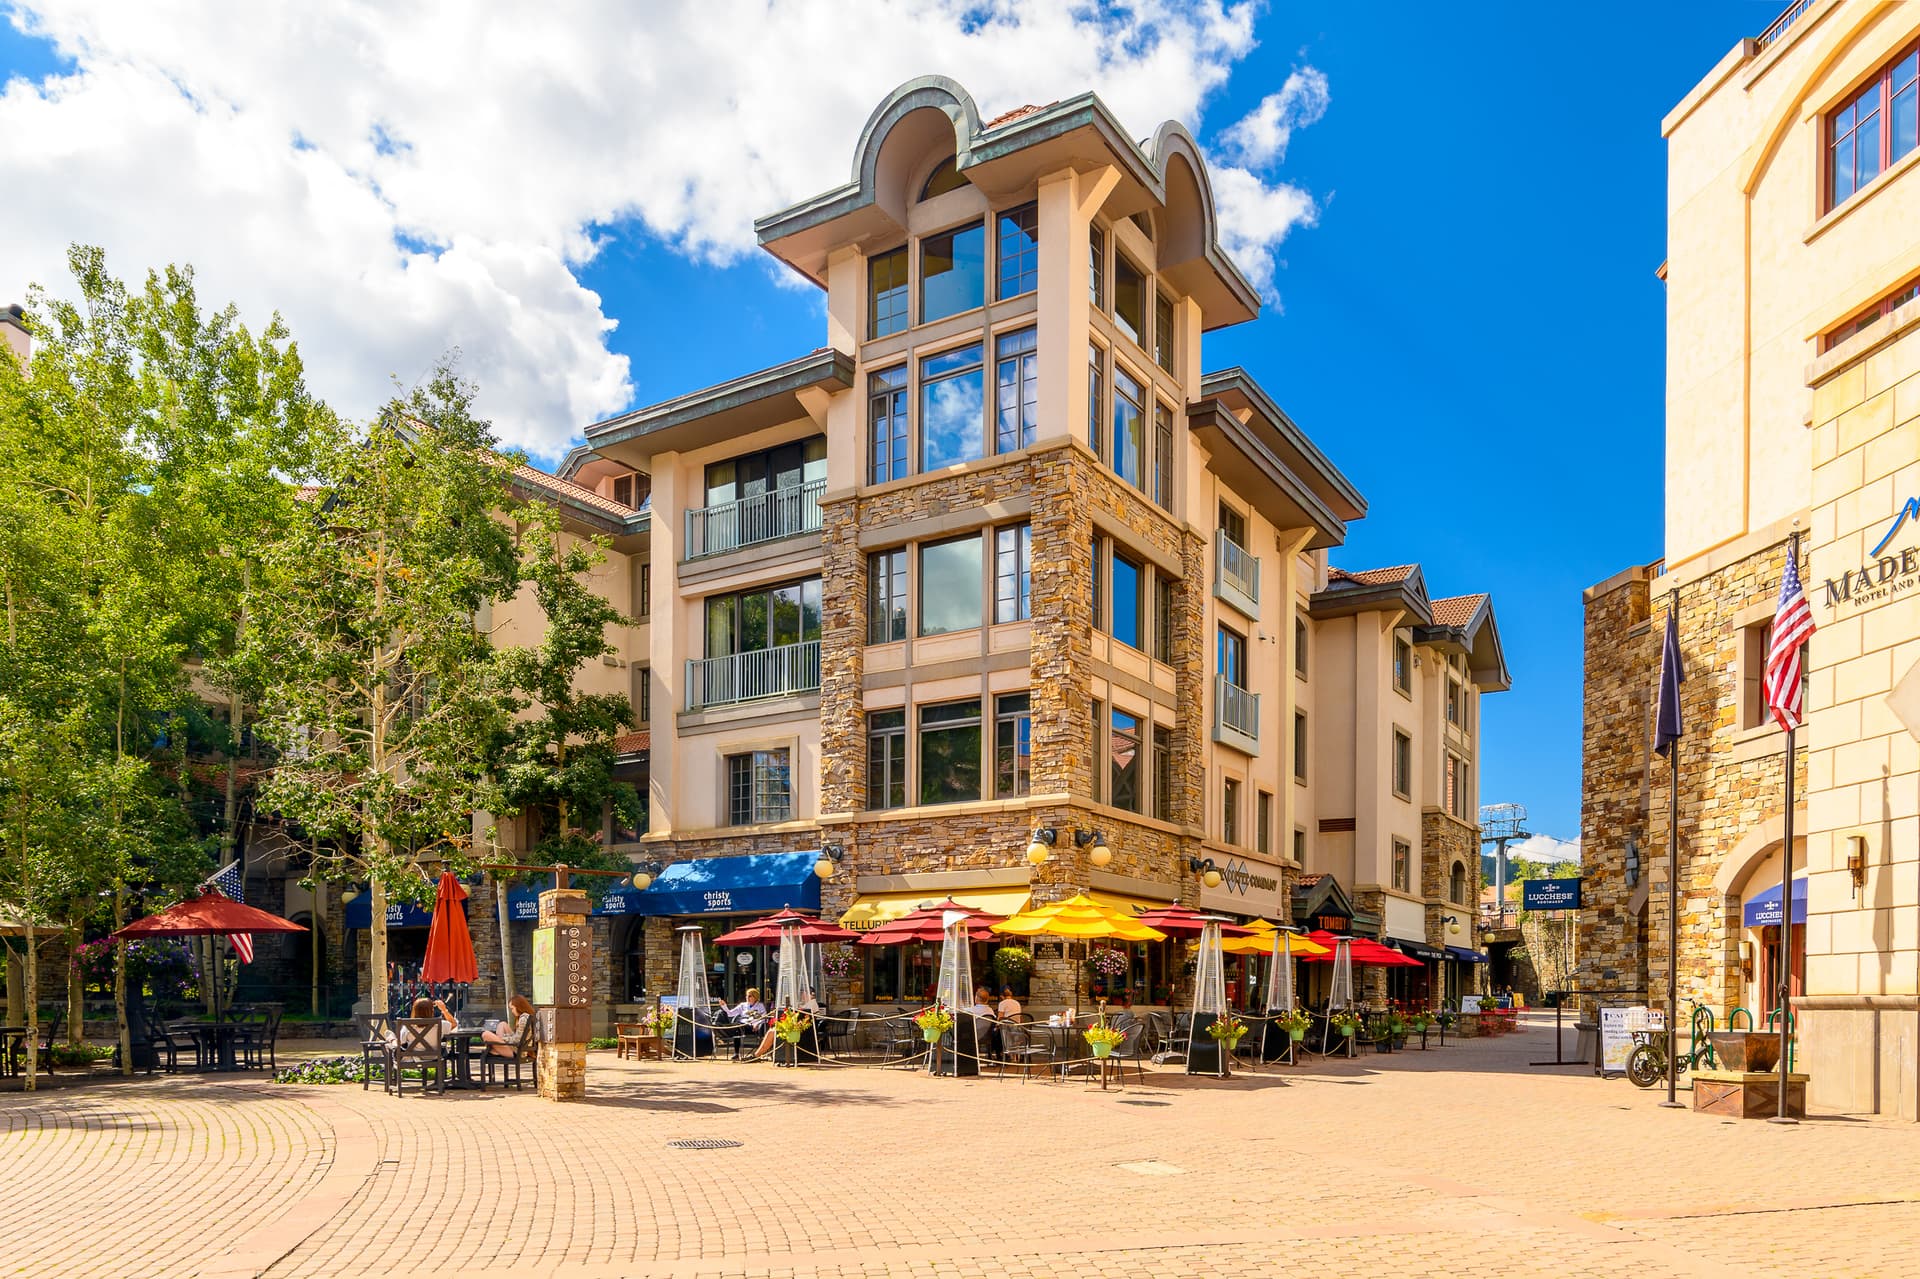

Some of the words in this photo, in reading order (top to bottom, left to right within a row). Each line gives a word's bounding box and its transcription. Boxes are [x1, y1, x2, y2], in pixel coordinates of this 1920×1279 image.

[1823, 546, 1920, 609] MADE
[1854, 588, 1888, 606] HOTEL
[1891, 578, 1914, 593] AND
[1250, 874, 1277, 891] COMPANY
[704, 891, 730, 900] christy
[1528, 893, 1573, 901] LUCCHESE
[516, 901, 536, 909] christy
[707, 899, 731, 907] sports
[386, 912, 404, 920] ports
[1755, 911, 1783, 920] LUCCHES
